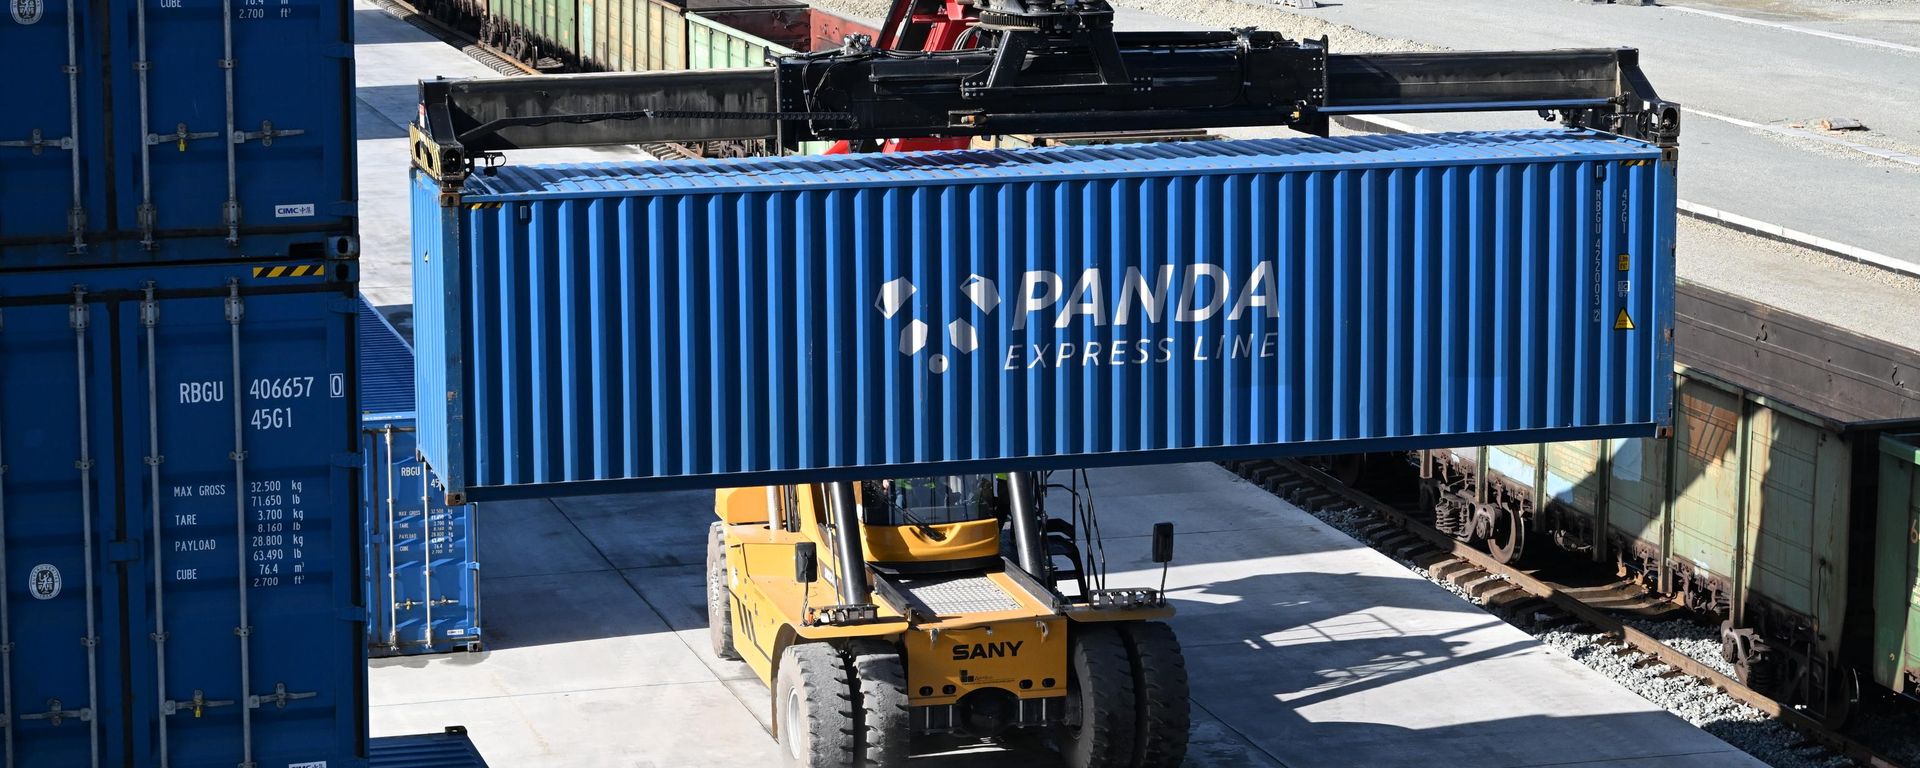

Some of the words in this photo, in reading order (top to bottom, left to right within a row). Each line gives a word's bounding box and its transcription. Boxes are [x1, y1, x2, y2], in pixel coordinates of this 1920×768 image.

[239, 8, 264, 19] 2.700
[277, 207, 299, 215] CIMC
[1012, 260, 1280, 331] PANDA
[1004, 337, 1175, 371] EXPRESS
[1193, 332, 1279, 361] LINE
[179, 381, 224, 404] RBGU
[250, 376, 314, 400] 406657
[331, 374, 343, 397] 0
[251, 407, 292, 430] 45G1
[401, 466, 421, 477] RBGU
[174, 486, 193, 497] MAX
[199, 484, 226, 496] GROSS
[251, 480, 281, 492] 32.500
[291, 480, 302, 493] kg
[251, 495, 282, 507] 71.650
[292, 494, 301, 505] lb
[175, 514, 197, 526] TARE
[258, 508, 283, 520] 3.700
[293, 508, 304, 521] kg
[258, 523, 283, 533] 8.160
[293, 522, 301, 531] lb
[175, 539, 216, 552] PAYLOAD
[252, 534, 283, 547] 28.800
[293, 534, 304, 547] kg
[253, 548, 283, 561] 63.490
[293, 548, 302, 559] lb
[176, 568, 198, 580] CUBE
[259, 563, 279, 575] 76.4
[253, 577, 279, 587] 2.700
[952, 640, 1024, 661] SANY
